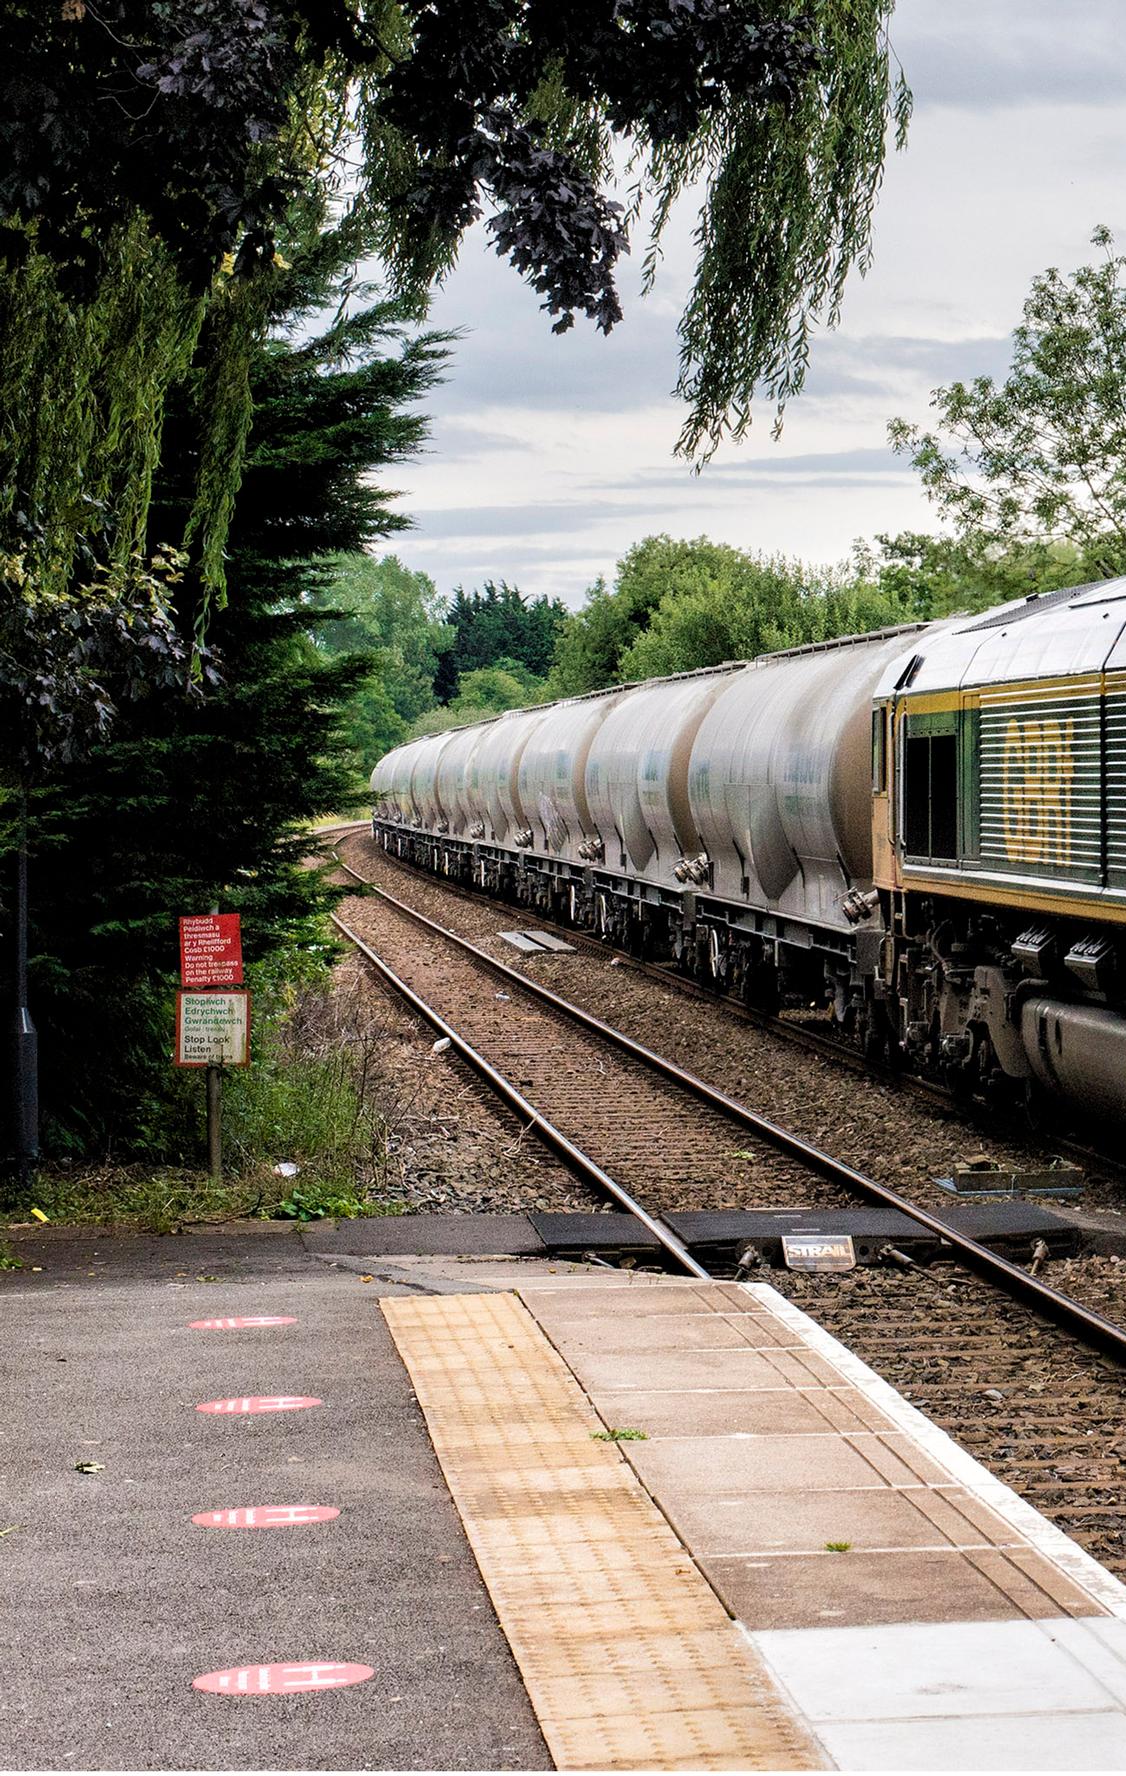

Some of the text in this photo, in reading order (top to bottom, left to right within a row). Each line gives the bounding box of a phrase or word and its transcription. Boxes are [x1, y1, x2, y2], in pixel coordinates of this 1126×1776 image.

[208, 967, 233, 975] railway
[185, 1007, 233, 1016] Edrychwch
[184, 1035, 230, 1044] Stop Look
[184, 1045, 212, 1053] Listen
[785, 1244, 852, 1257] STRAIL
